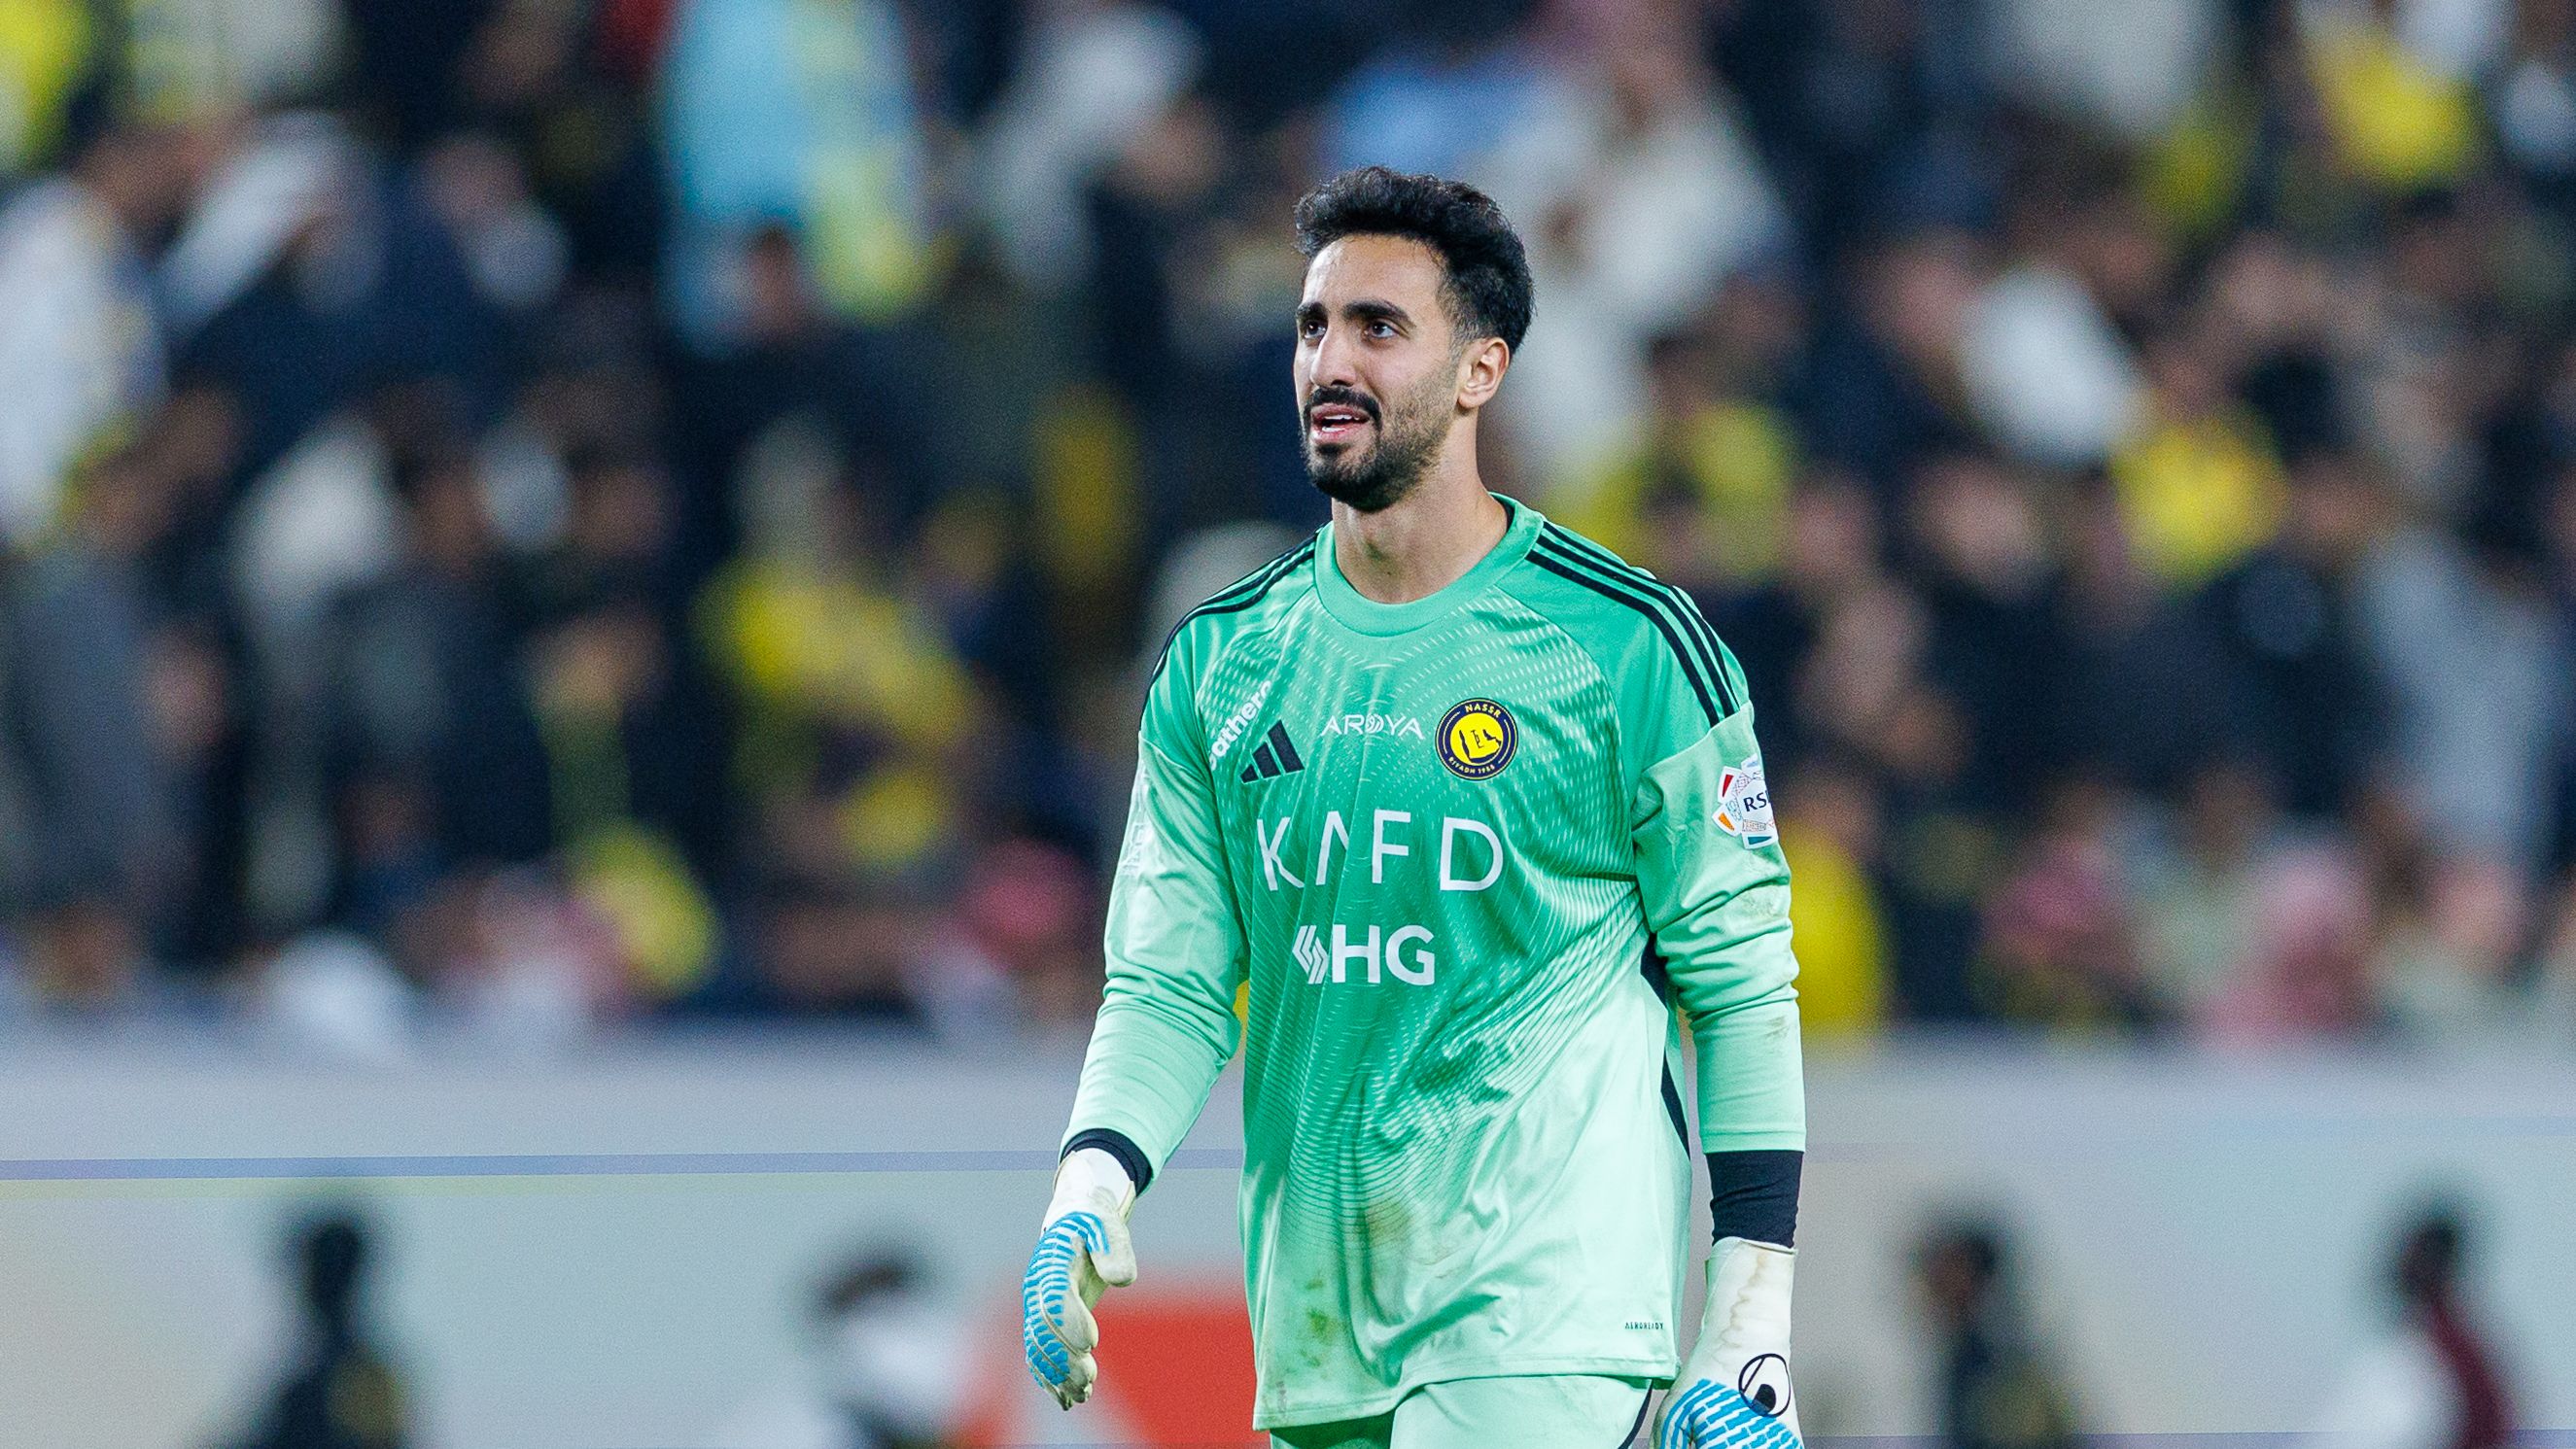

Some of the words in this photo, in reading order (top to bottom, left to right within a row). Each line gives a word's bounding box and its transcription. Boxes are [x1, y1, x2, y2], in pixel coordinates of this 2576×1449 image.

[1465, 703, 1501, 718] NASSR
[1320, 713, 1425, 740] AROYA
[1257, 809, 1504, 891] KAFD
